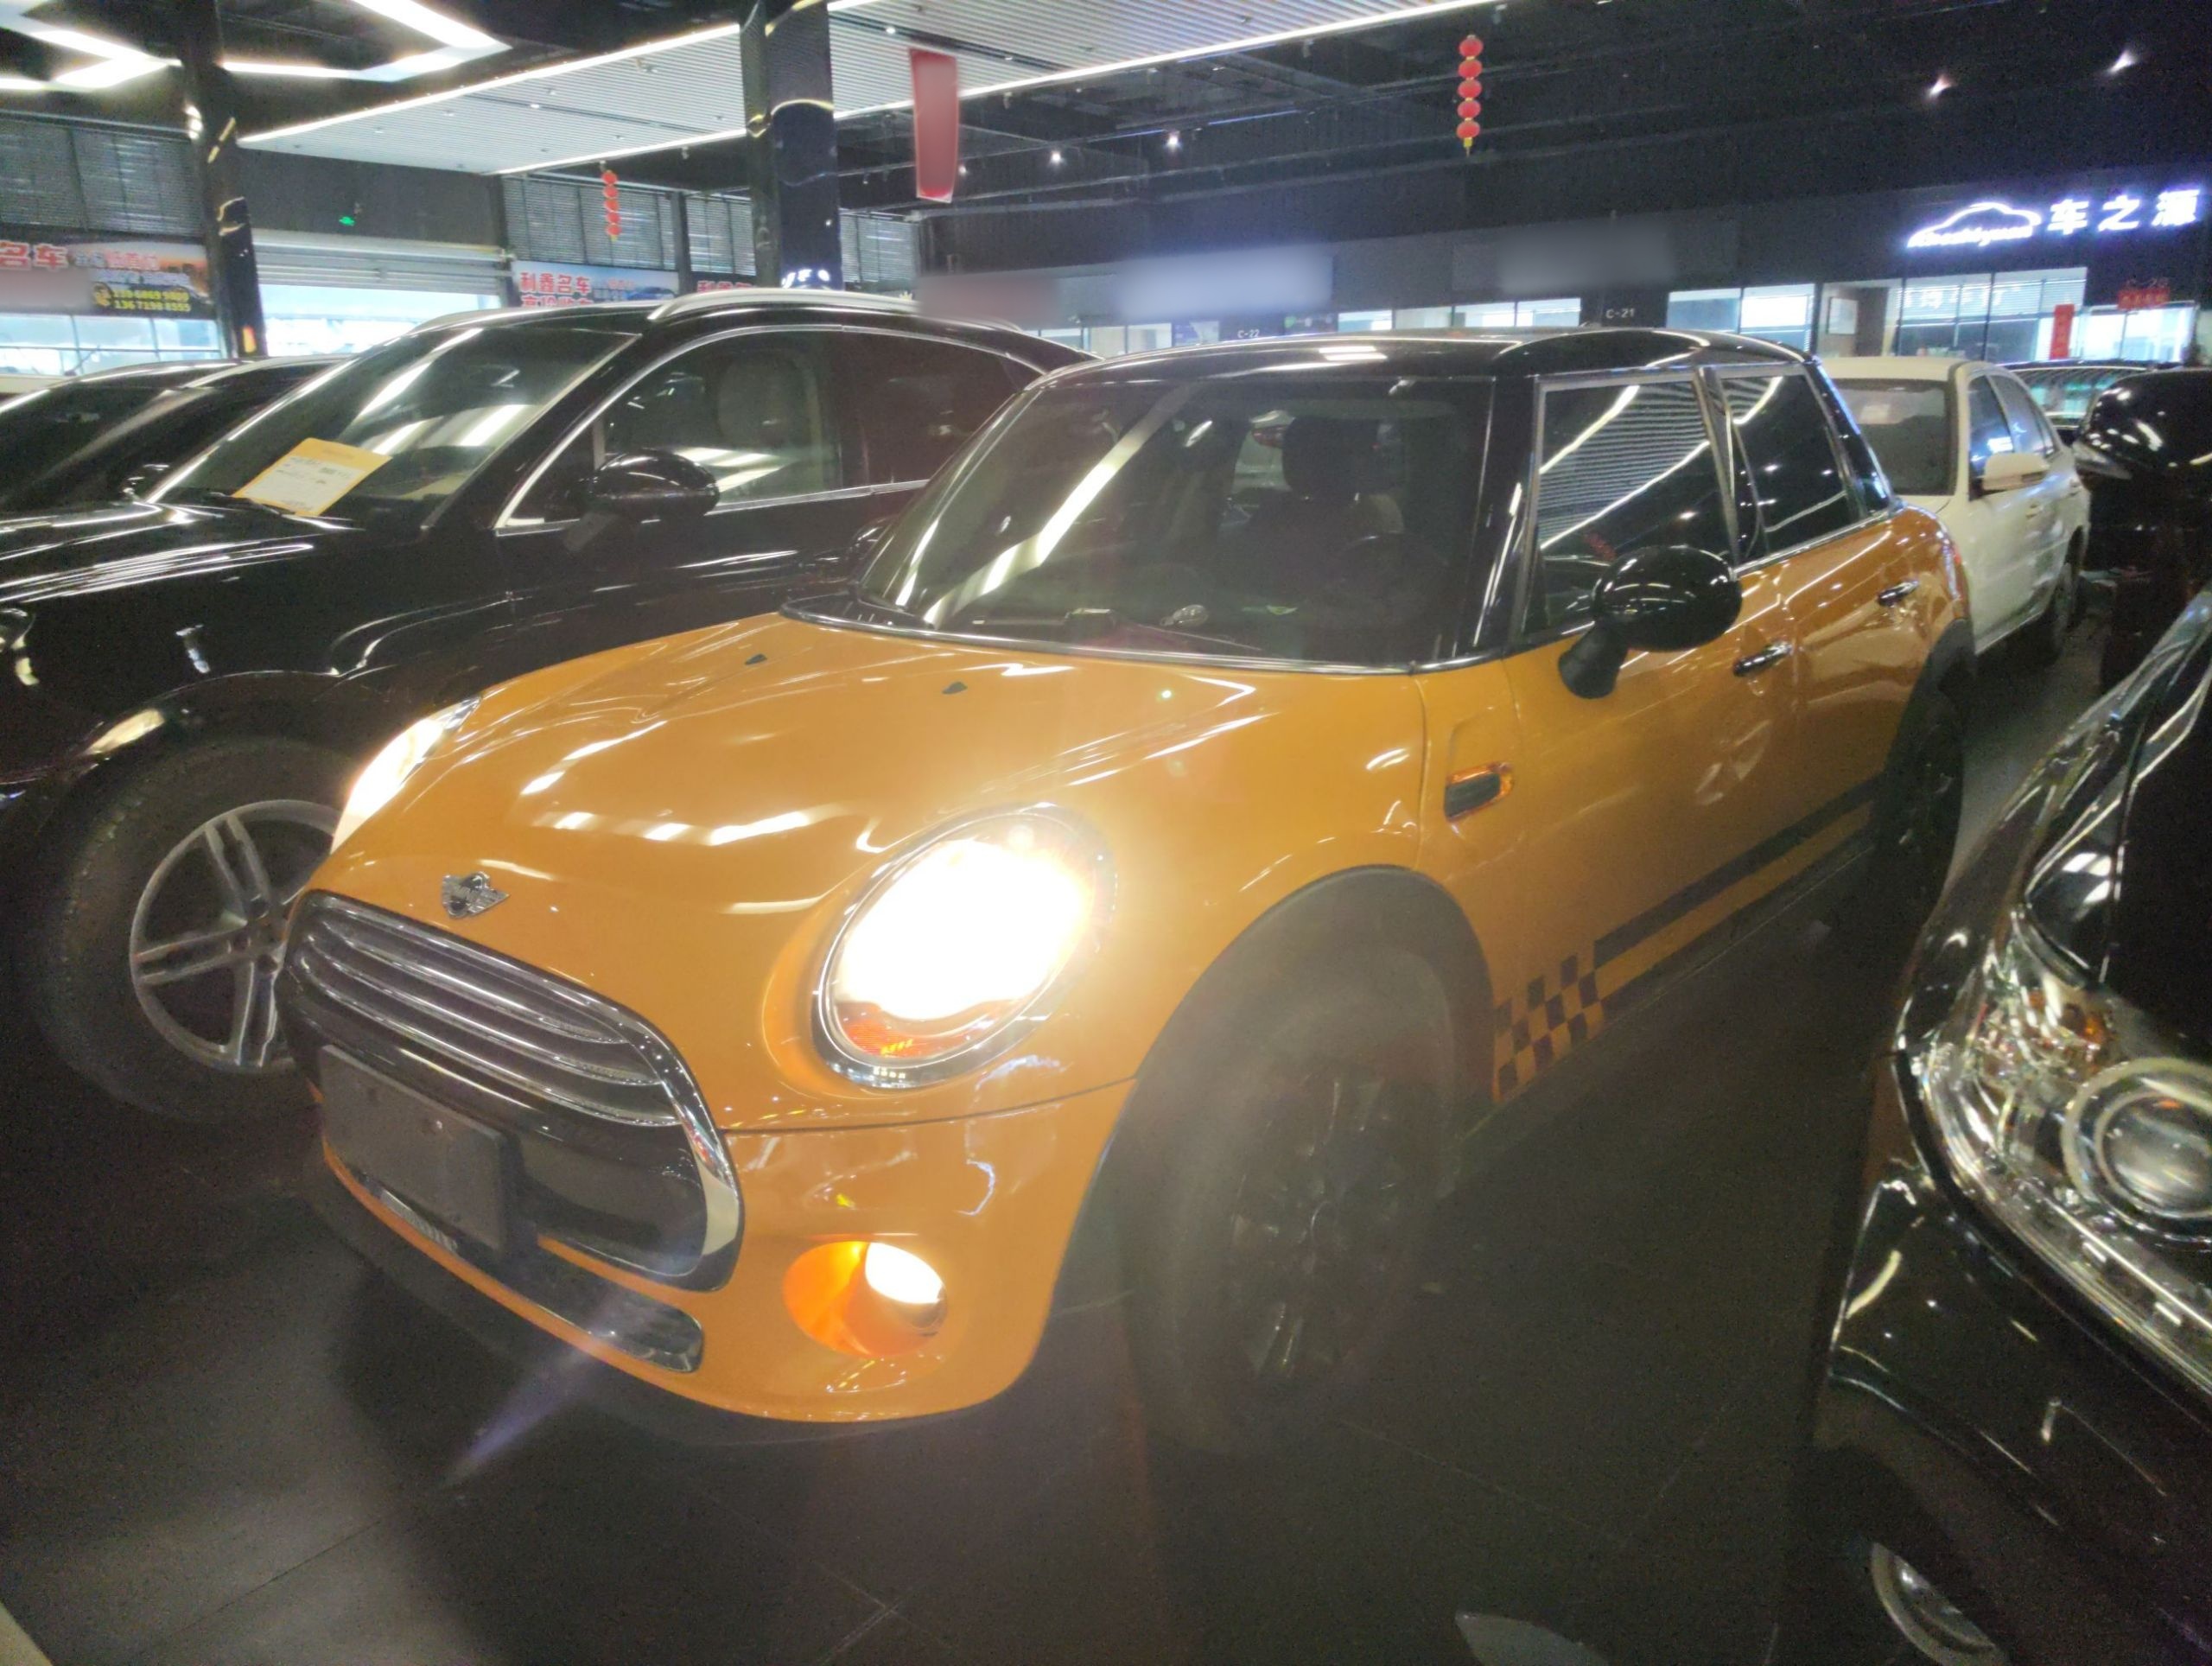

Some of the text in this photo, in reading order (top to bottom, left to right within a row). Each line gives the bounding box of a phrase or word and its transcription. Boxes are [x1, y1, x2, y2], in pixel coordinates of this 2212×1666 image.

[520, 271, 591, 296] 利鑫名车
[1605, 308, 1636, 319] C-21
[1237, 328, 1260, 339] C-22
